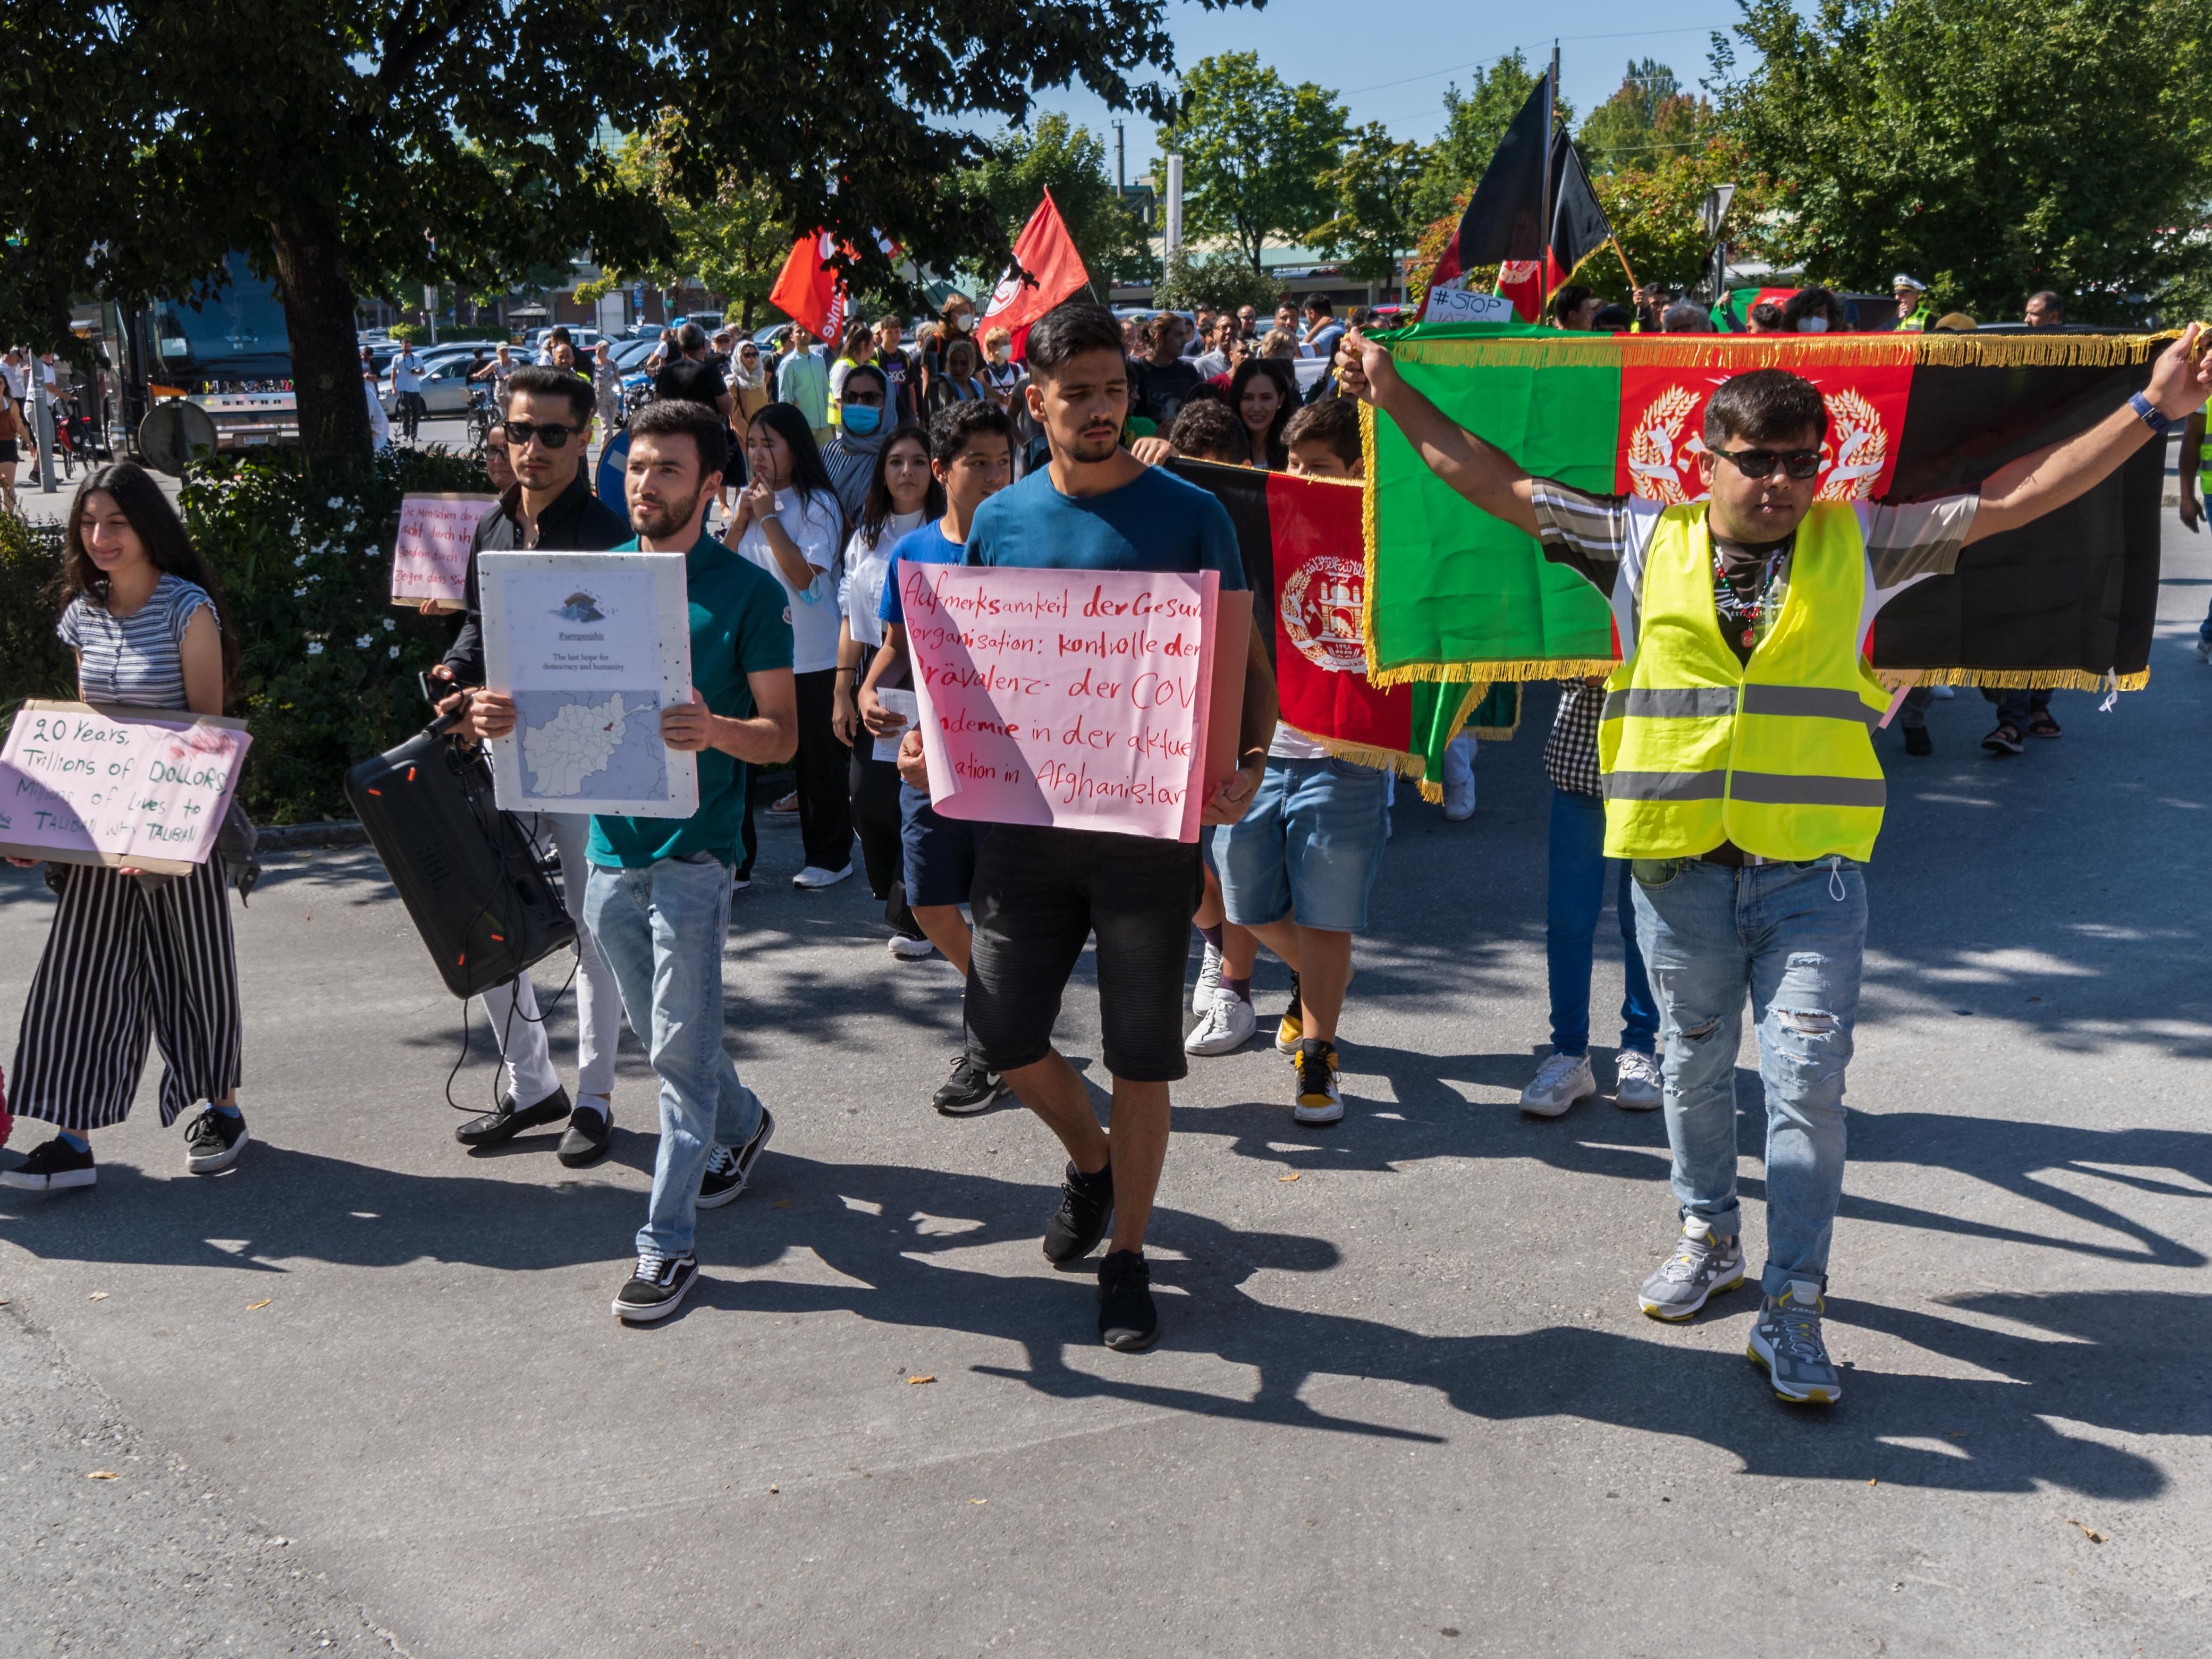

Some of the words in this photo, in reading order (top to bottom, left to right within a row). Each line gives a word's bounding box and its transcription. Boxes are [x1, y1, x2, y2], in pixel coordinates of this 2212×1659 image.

[1433, 290, 1501, 313] #STOP
[417, 506, 457, 520] Menschen
[401, 522, 424, 538] nicht
[430, 526, 455, 542] durch
[433, 548, 458, 563] durch
[427, 566, 447, 584] dass
[903, 570, 1068, 619] Aufmerksamkeit
[1083, 584, 1128, 618] der
[1164, 632, 1201, 657] der
[543, 663, 578, 672] democracy
[593, 663, 624, 672] humanity
[581, 653, 597, 663] hope
[1068, 667, 1122, 699] der
[32, 718, 66, 742] 20
[72, 719, 130, 746] Years,
[1032, 720, 1050, 742] in
[1062, 714, 1117, 749] der
[22, 748, 96, 776] Trillions
[108, 758, 135, 780] of
[1004, 763, 1019, 784] in
[90, 786, 118, 806] of
[182, 799, 202, 818] to
